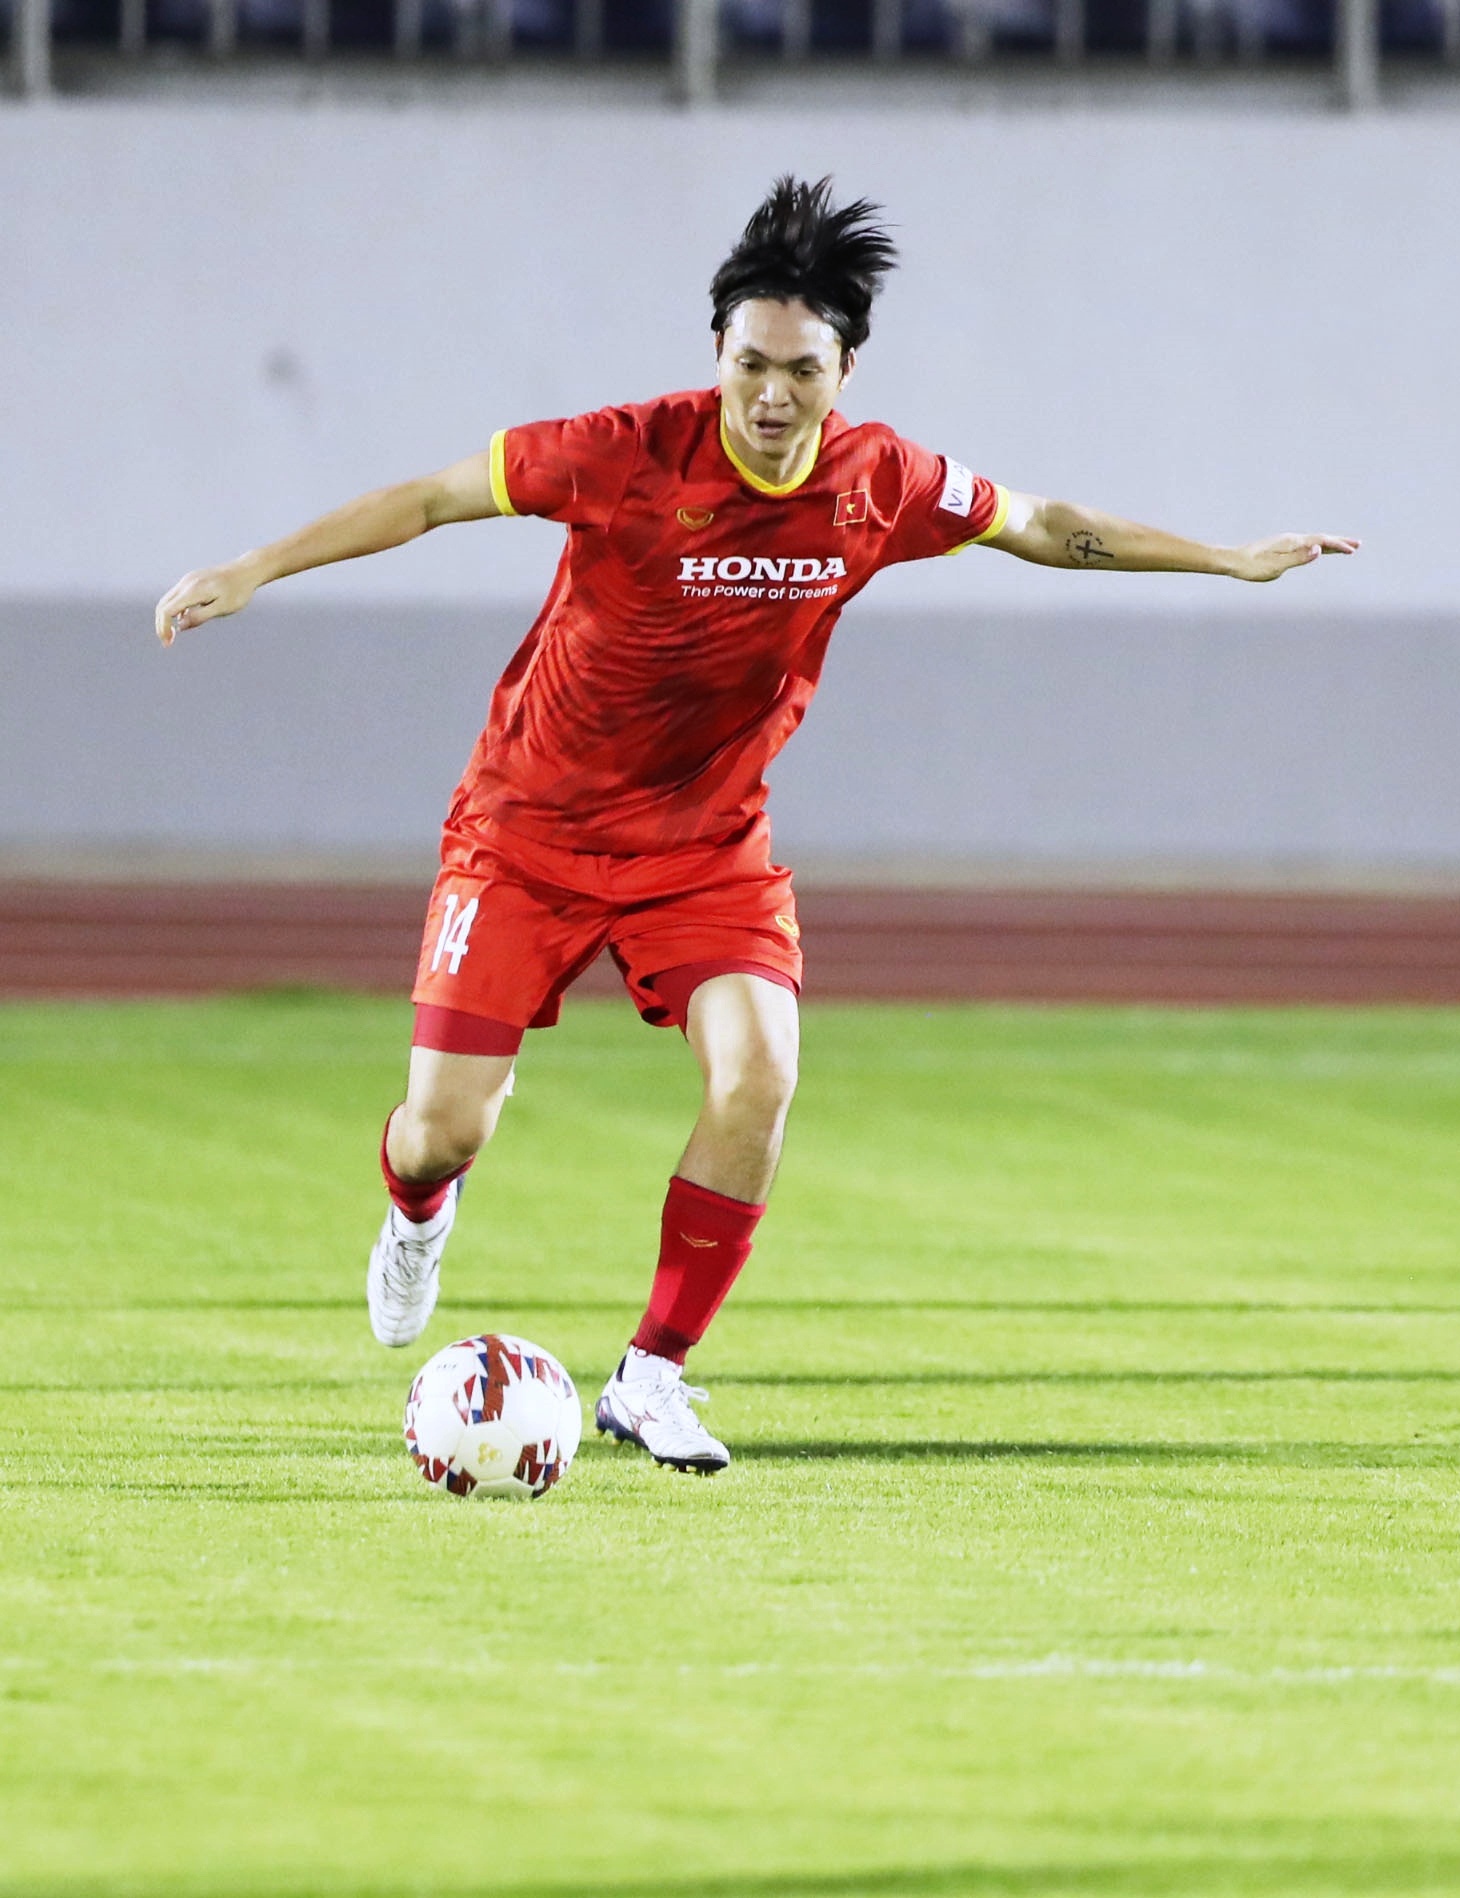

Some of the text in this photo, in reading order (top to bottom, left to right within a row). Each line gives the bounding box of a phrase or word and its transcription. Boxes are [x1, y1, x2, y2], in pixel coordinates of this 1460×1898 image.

[676, 556, 847, 582] HONDA
[681, 583, 838, 600] The Power of Dreams
[430, 893, 480, 975] 14
